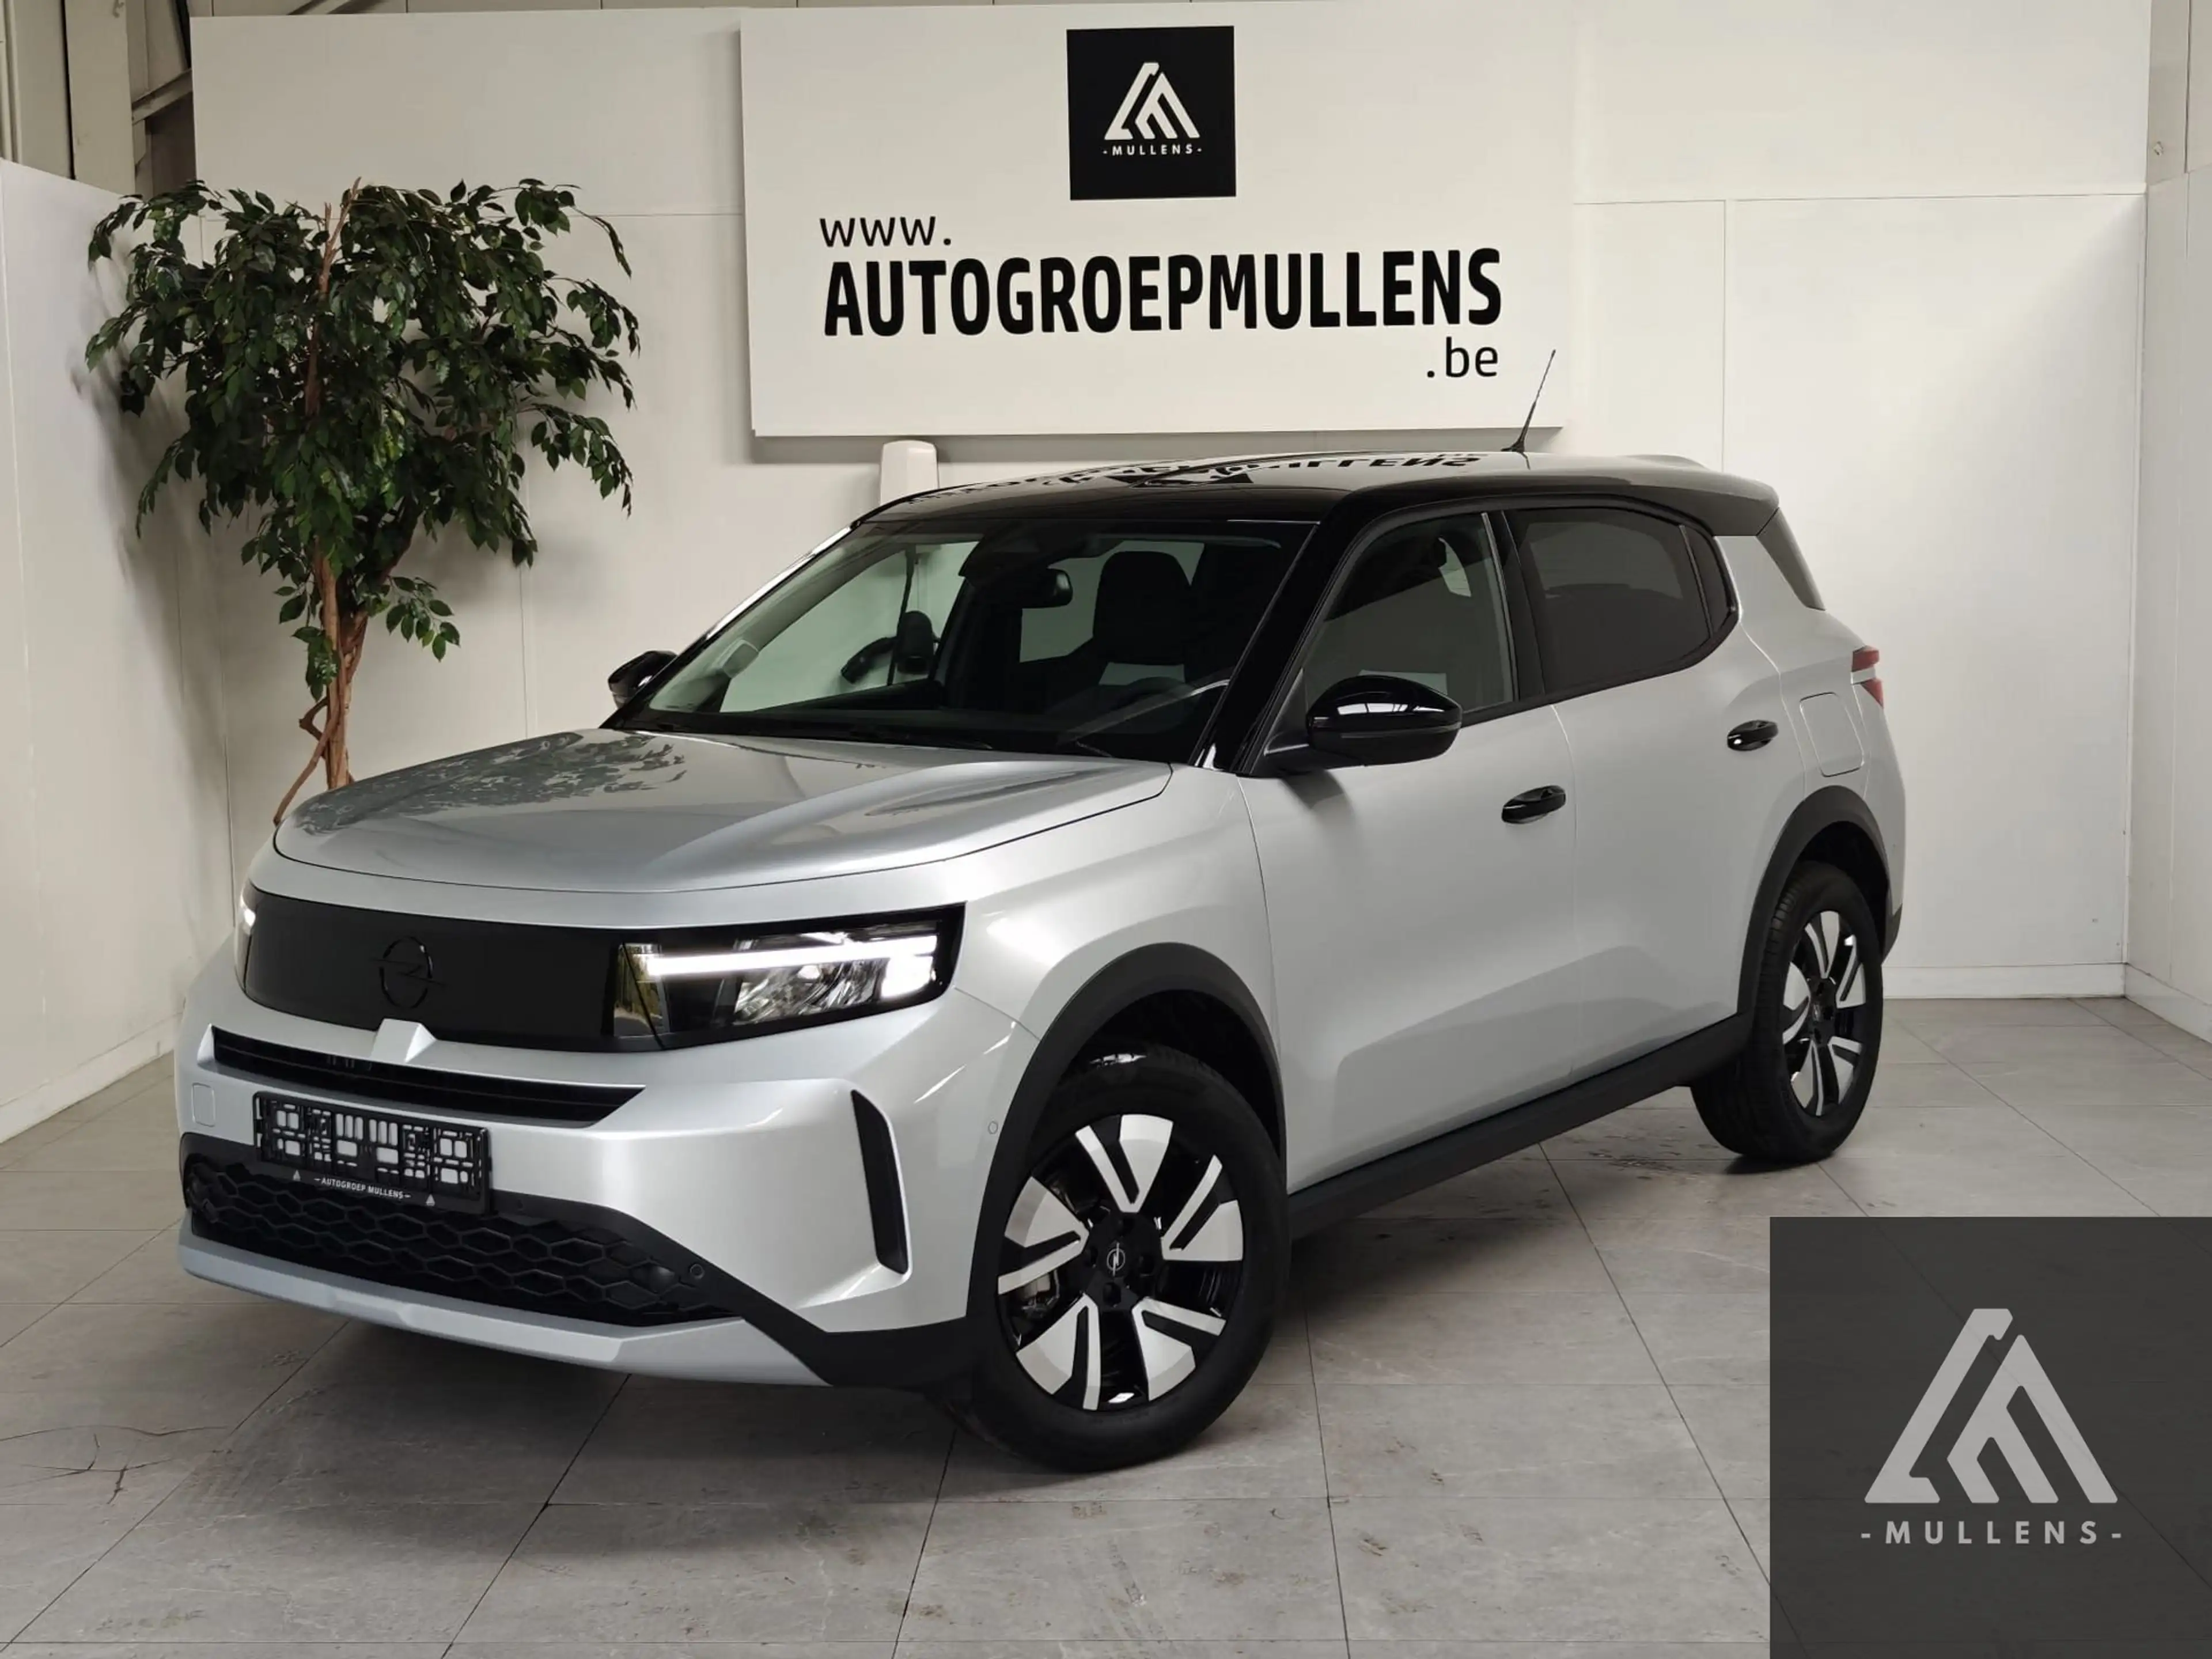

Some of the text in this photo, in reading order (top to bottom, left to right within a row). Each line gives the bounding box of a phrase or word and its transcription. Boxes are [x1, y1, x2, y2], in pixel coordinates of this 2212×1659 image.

[819, 215, 952, 248] www.
[824, 248, 1502, 336] AUTOGROEPMULLENS
[1426, 336, 1498, 378] .be
